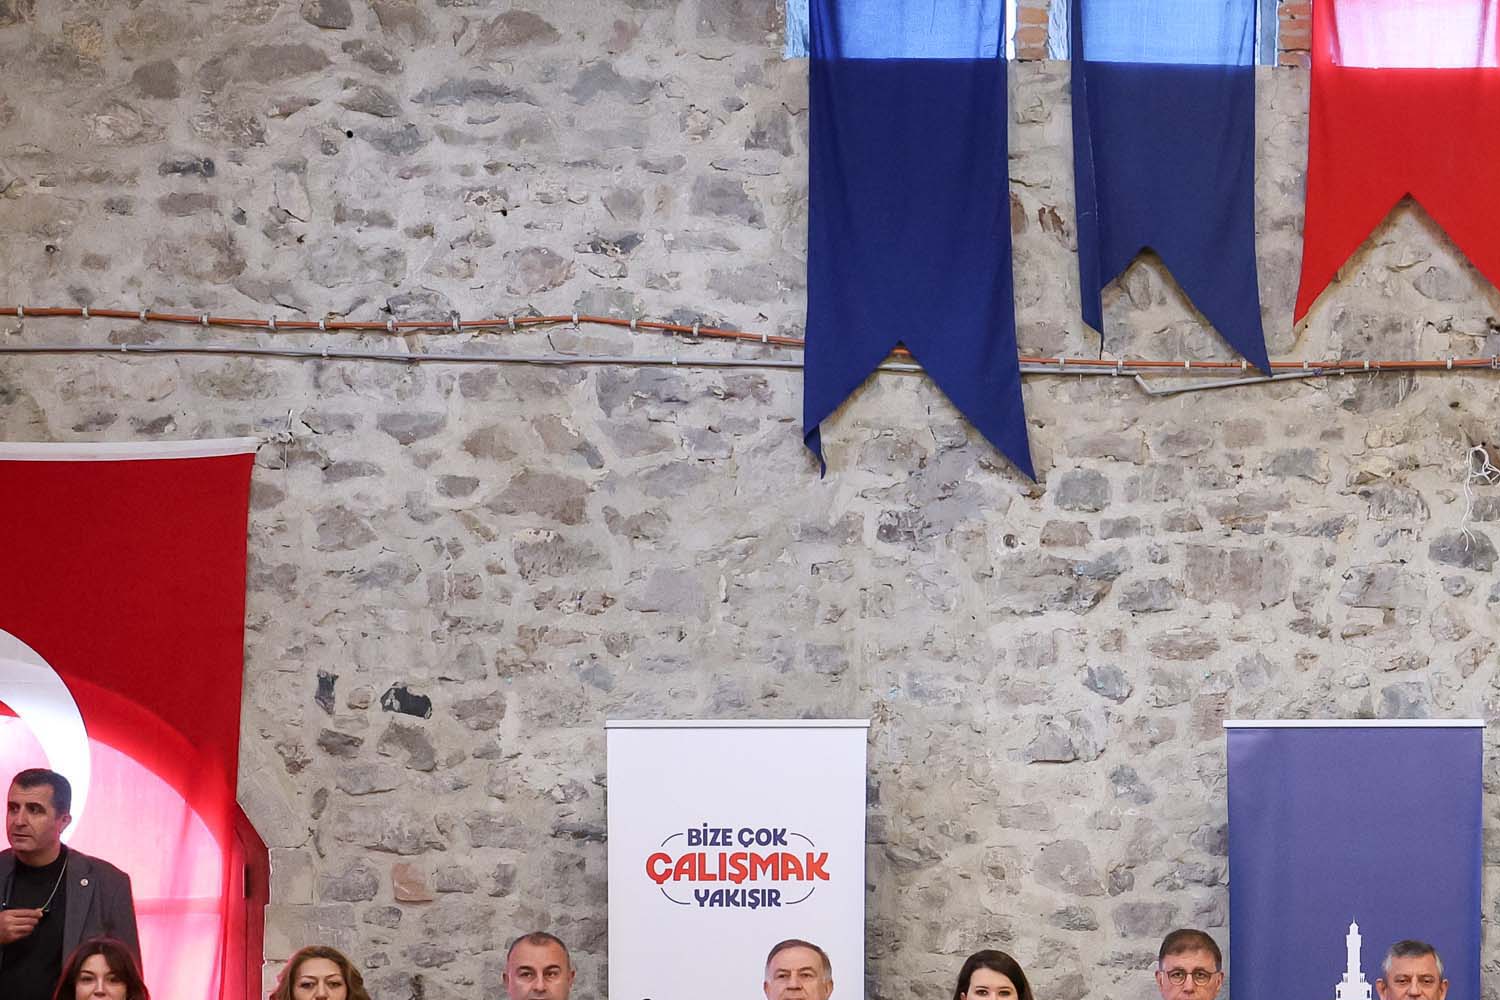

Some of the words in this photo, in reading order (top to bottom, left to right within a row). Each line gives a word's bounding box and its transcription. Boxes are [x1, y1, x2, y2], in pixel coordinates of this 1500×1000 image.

[687, 822, 733, 847] BİZE
[737, 827, 788, 848] ÇOK
[645, 852, 830, 884] ÇALIŞMAK
[693, 888, 782, 909] YAKIŞIR
